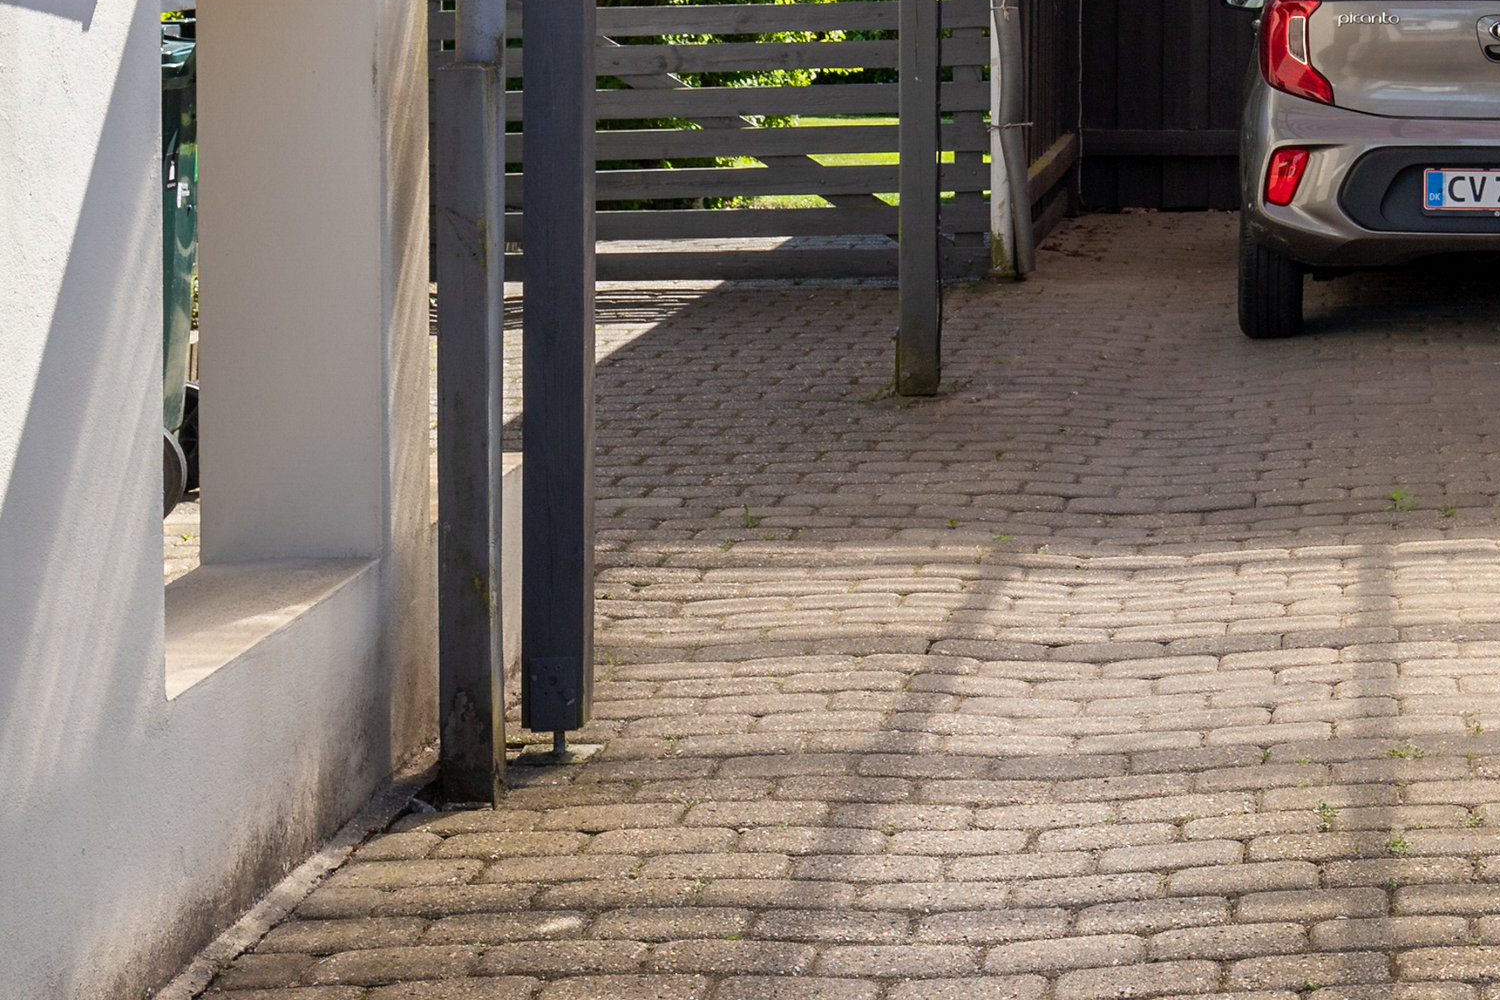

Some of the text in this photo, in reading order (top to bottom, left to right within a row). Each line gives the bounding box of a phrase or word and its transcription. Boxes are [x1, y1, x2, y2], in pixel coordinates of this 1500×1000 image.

[1337, 11, 1400, 27] picanto
[1429, 192, 1441, 201] DK
[1447, 175, 1487, 203] CV
